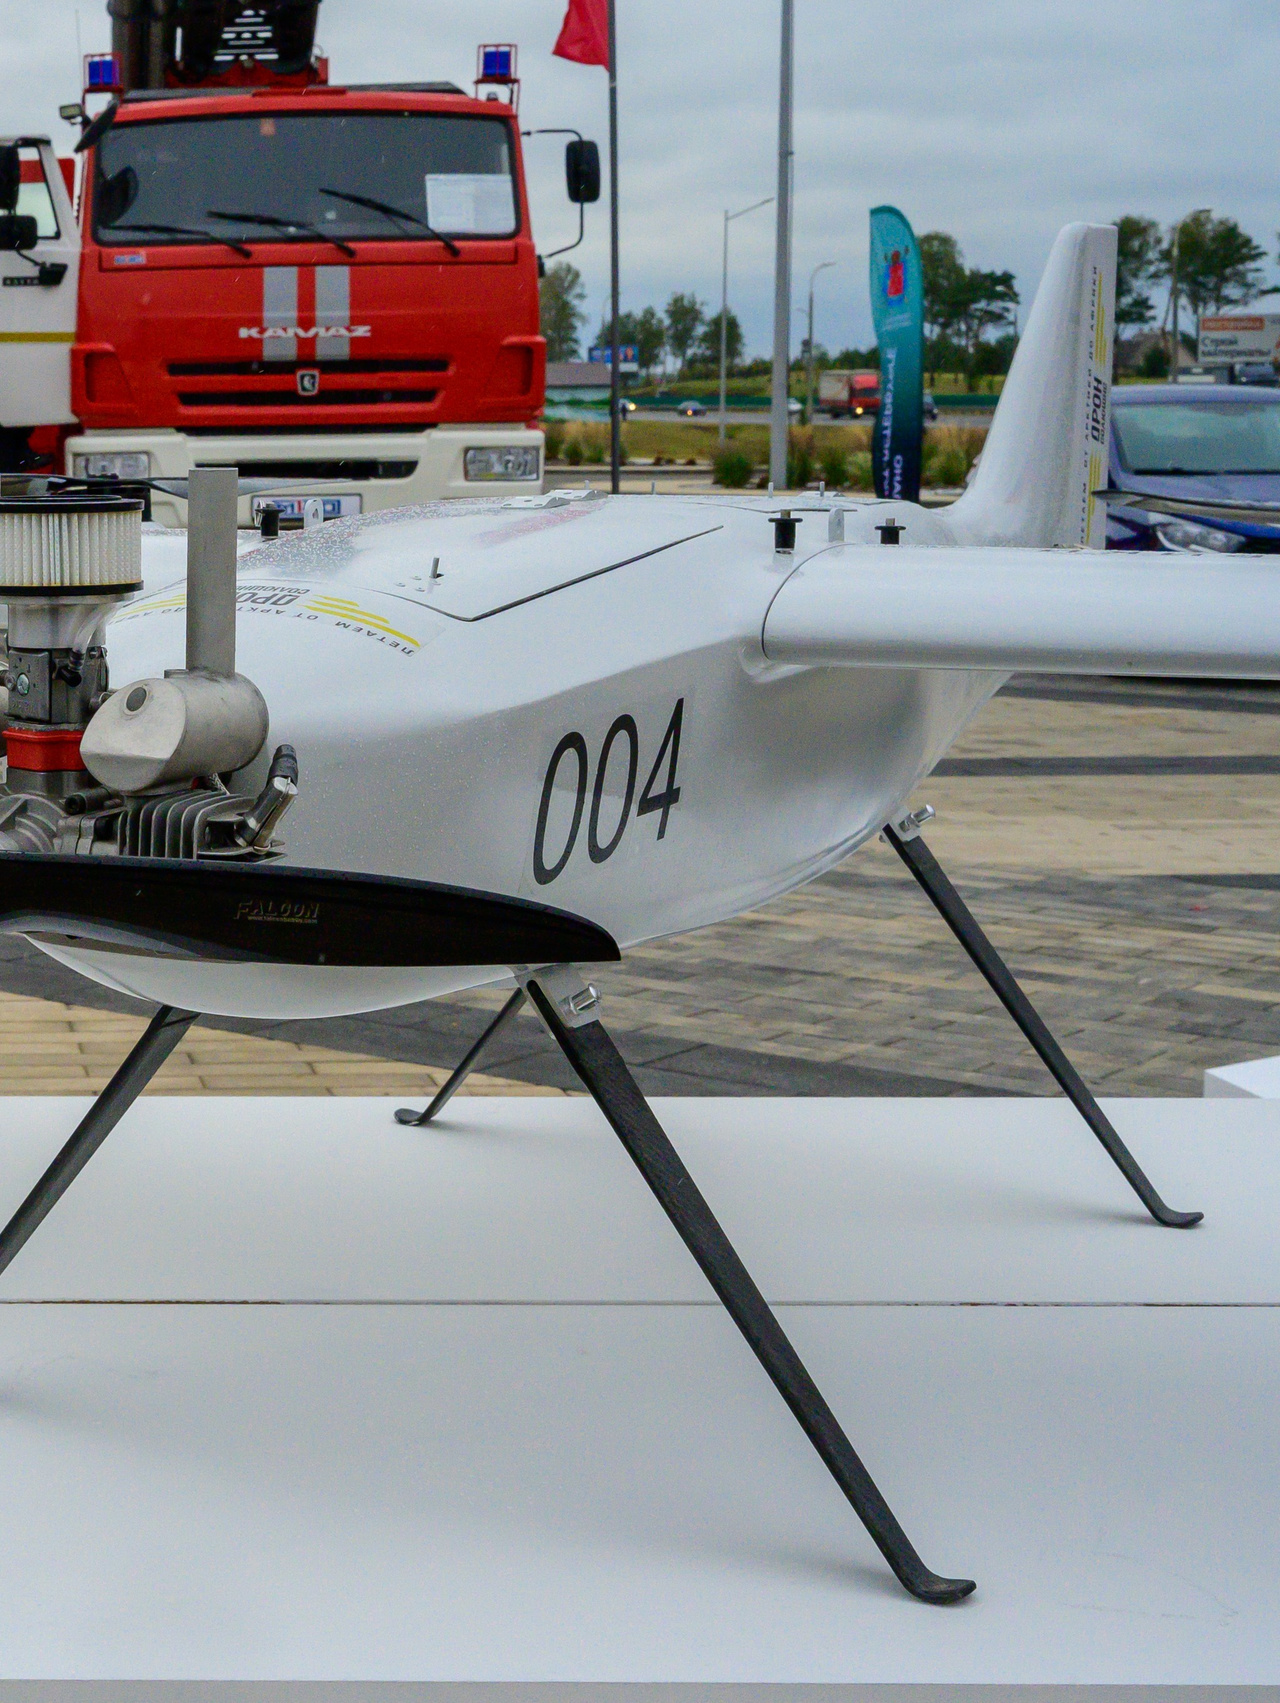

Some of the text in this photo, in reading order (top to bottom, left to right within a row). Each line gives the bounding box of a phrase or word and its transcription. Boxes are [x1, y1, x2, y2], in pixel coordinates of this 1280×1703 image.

[238, 325, 371, 339] KAMAZ
[293, 612, 319, 620] ОТ
[335, 621, 415, 655] ЛЕТАЕМ
[533, 697, 684, 885] 004
[233, 901, 319, 919] FALCON
